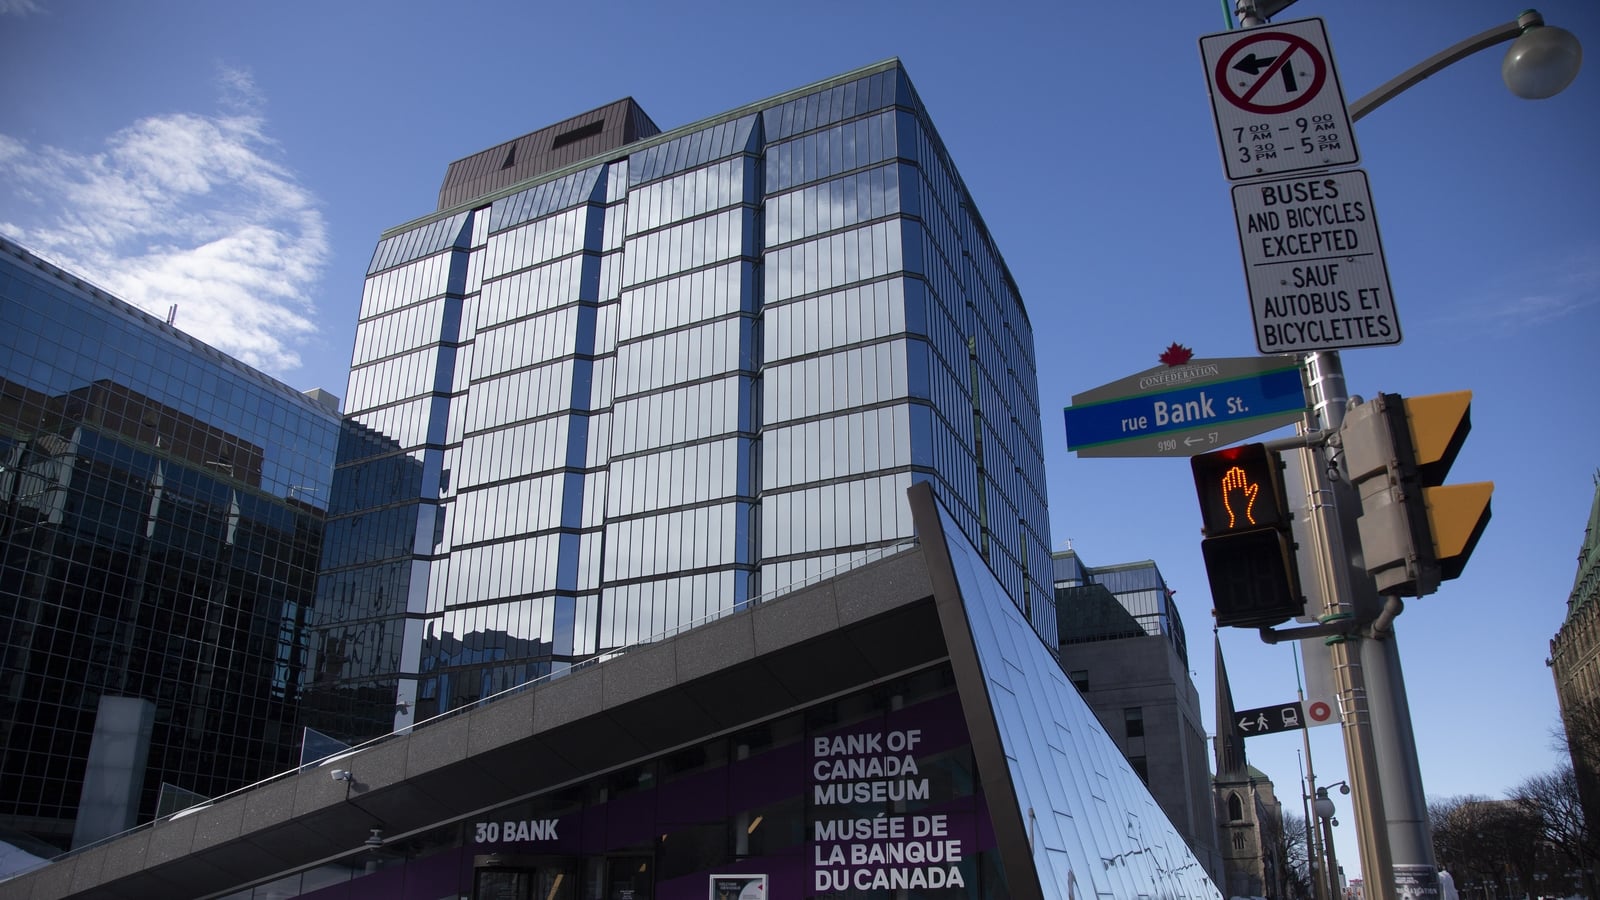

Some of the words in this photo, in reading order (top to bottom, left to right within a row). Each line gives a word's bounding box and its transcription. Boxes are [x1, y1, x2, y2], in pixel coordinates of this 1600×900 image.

[1250, 123, 1270, 132] 00
[1296, 117, 1308, 134] 9
[1312, 113, 1333, 123] 00
[1315, 122, 1336, 131] AM
[1233, 127, 1244, 143] 7
[1252, 132, 1272, 141] AM
[1255, 142, 1274, 151] 30
[1301, 137, 1314, 154] 5
[1317, 133, 1338, 143] 30
[1319, 142, 1341, 151] PM
[1239, 147, 1251, 163] 3
[1255, 151, 1277, 161] PM
[1262, 179, 1339, 206] BUSES
[1248, 211, 1280, 234] AND
[1286, 201, 1366, 229] BICYCLES
[1262, 229, 1358, 258] EXCEPTED
[1292, 264, 1339, 288] SAUF
[1264, 290, 1350, 319] AUTOBUS
[1358, 288, 1380, 310] ET
[1263, 315, 1391, 346] BICYCLETTES
[1121, 415, 1148, 433] rue
[1154, 392, 1215, 426] Bank
[1227, 396, 1249, 415] St.
[1157, 440, 1177, 452] 9190
[1208, 432, 1219, 444] 57
[814, 733, 882, 757] BANK
[886, 729, 921, 752] OF
[813, 754, 919, 781] CANADA
[814, 778, 929, 805] MUSEUM
[475, 822, 499, 843] 30
[502, 819, 559, 842] BANK
[814, 812, 905, 841] MUSÉE
[912, 814, 948, 838] DE
[815, 844, 846, 866] LA
[851, 839, 962, 866] BANQUE
[815, 869, 850, 891] DU
[853, 865, 965, 892] CANADA
